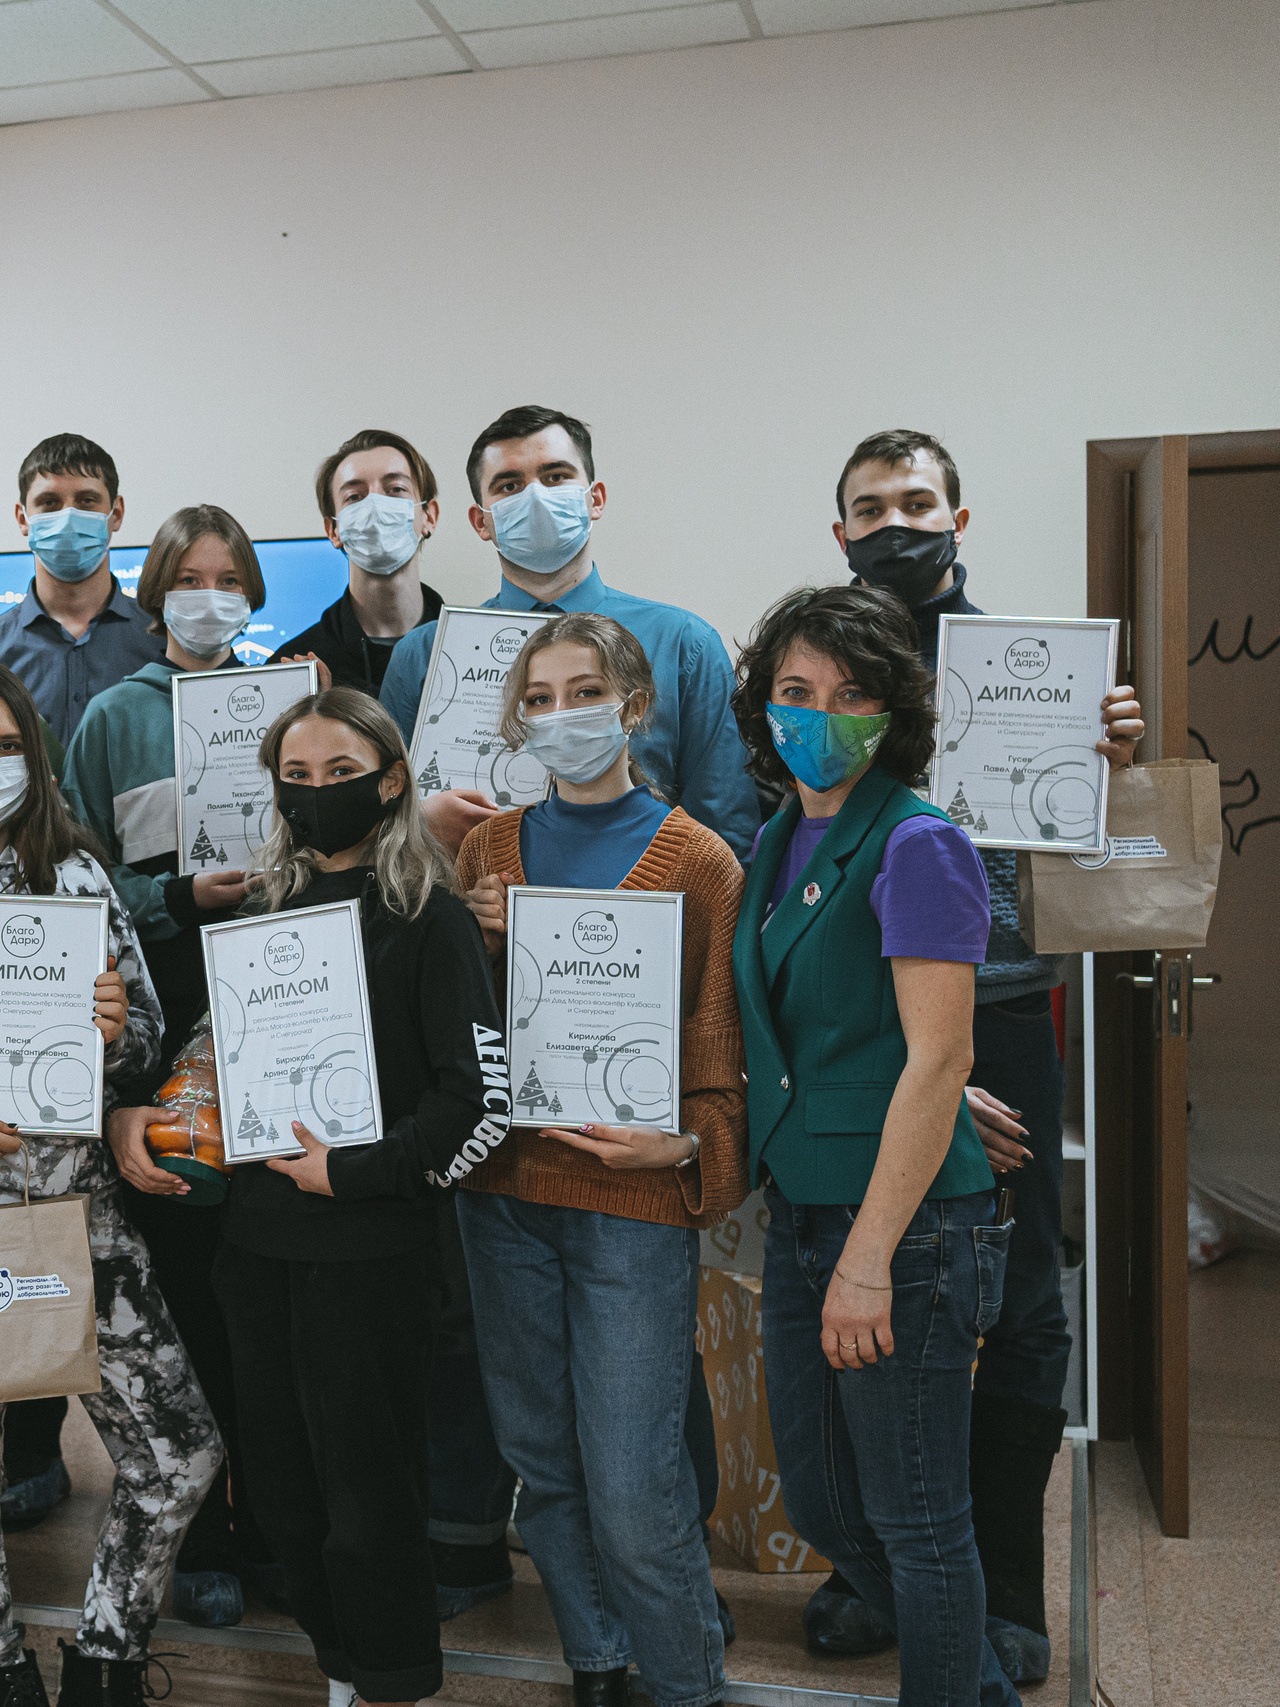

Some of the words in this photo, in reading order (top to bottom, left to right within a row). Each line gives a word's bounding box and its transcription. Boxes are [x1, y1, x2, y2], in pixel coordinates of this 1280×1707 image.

[495, 635, 520, 645] Благо
[1010, 648, 1039, 658] Благо
[1014, 658, 1044, 668] Дарю
[977, 685, 1070, 703] ДИПЛОМ
[230, 696, 255, 704] Благо
[235, 703, 260, 712] Дарю
[209, 727, 268, 747] ДИПЛО
[472, 729, 500, 737] Лебеде
[455, 737, 480, 745] Богдан
[1008, 755, 1032, 763] Гусев
[983, 764, 1009, 772] Павел
[207, 802, 233, 810] Полина
[7, 926, 35, 935] Благо
[578, 922, 607, 932] Благо
[10, 935, 40, 946] Дарю
[582, 932, 612, 942] Дарю
[268, 945, 294, 955] Благо
[273, 953, 300, 965] Дарю
[547, 960, 639, 978] ДИПЛОМ
[247, 976, 328, 1007] ДИПЛОМ
[54, 1000, 86, 1008] Кузбасса
[279, 999, 304, 1007] степени
[626, 1001, 660, 1009] Кузбасса
[299, 1007, 328, 1016] конкурса
[255, 1025, 269, 1033] Дед
[321, 1011, 352, 1022] Кузбасса
[5, 1036, 30, 1044] Песня
[568, 1032, 615, 1041] Кириллова
[0, 1048, 68, 1057] Константиновна
[546, 1042, 590, 1051] Елизавета
[592, 1045, 640, 1054] Сергеевна
[276, 1051, 315, 1065] Бирюкова
[264, 1070, 288, 1078] Арина
[290, 1060, 332, 1075] Сергеевна
[17, 1289, 68, 1298] добровольчества
